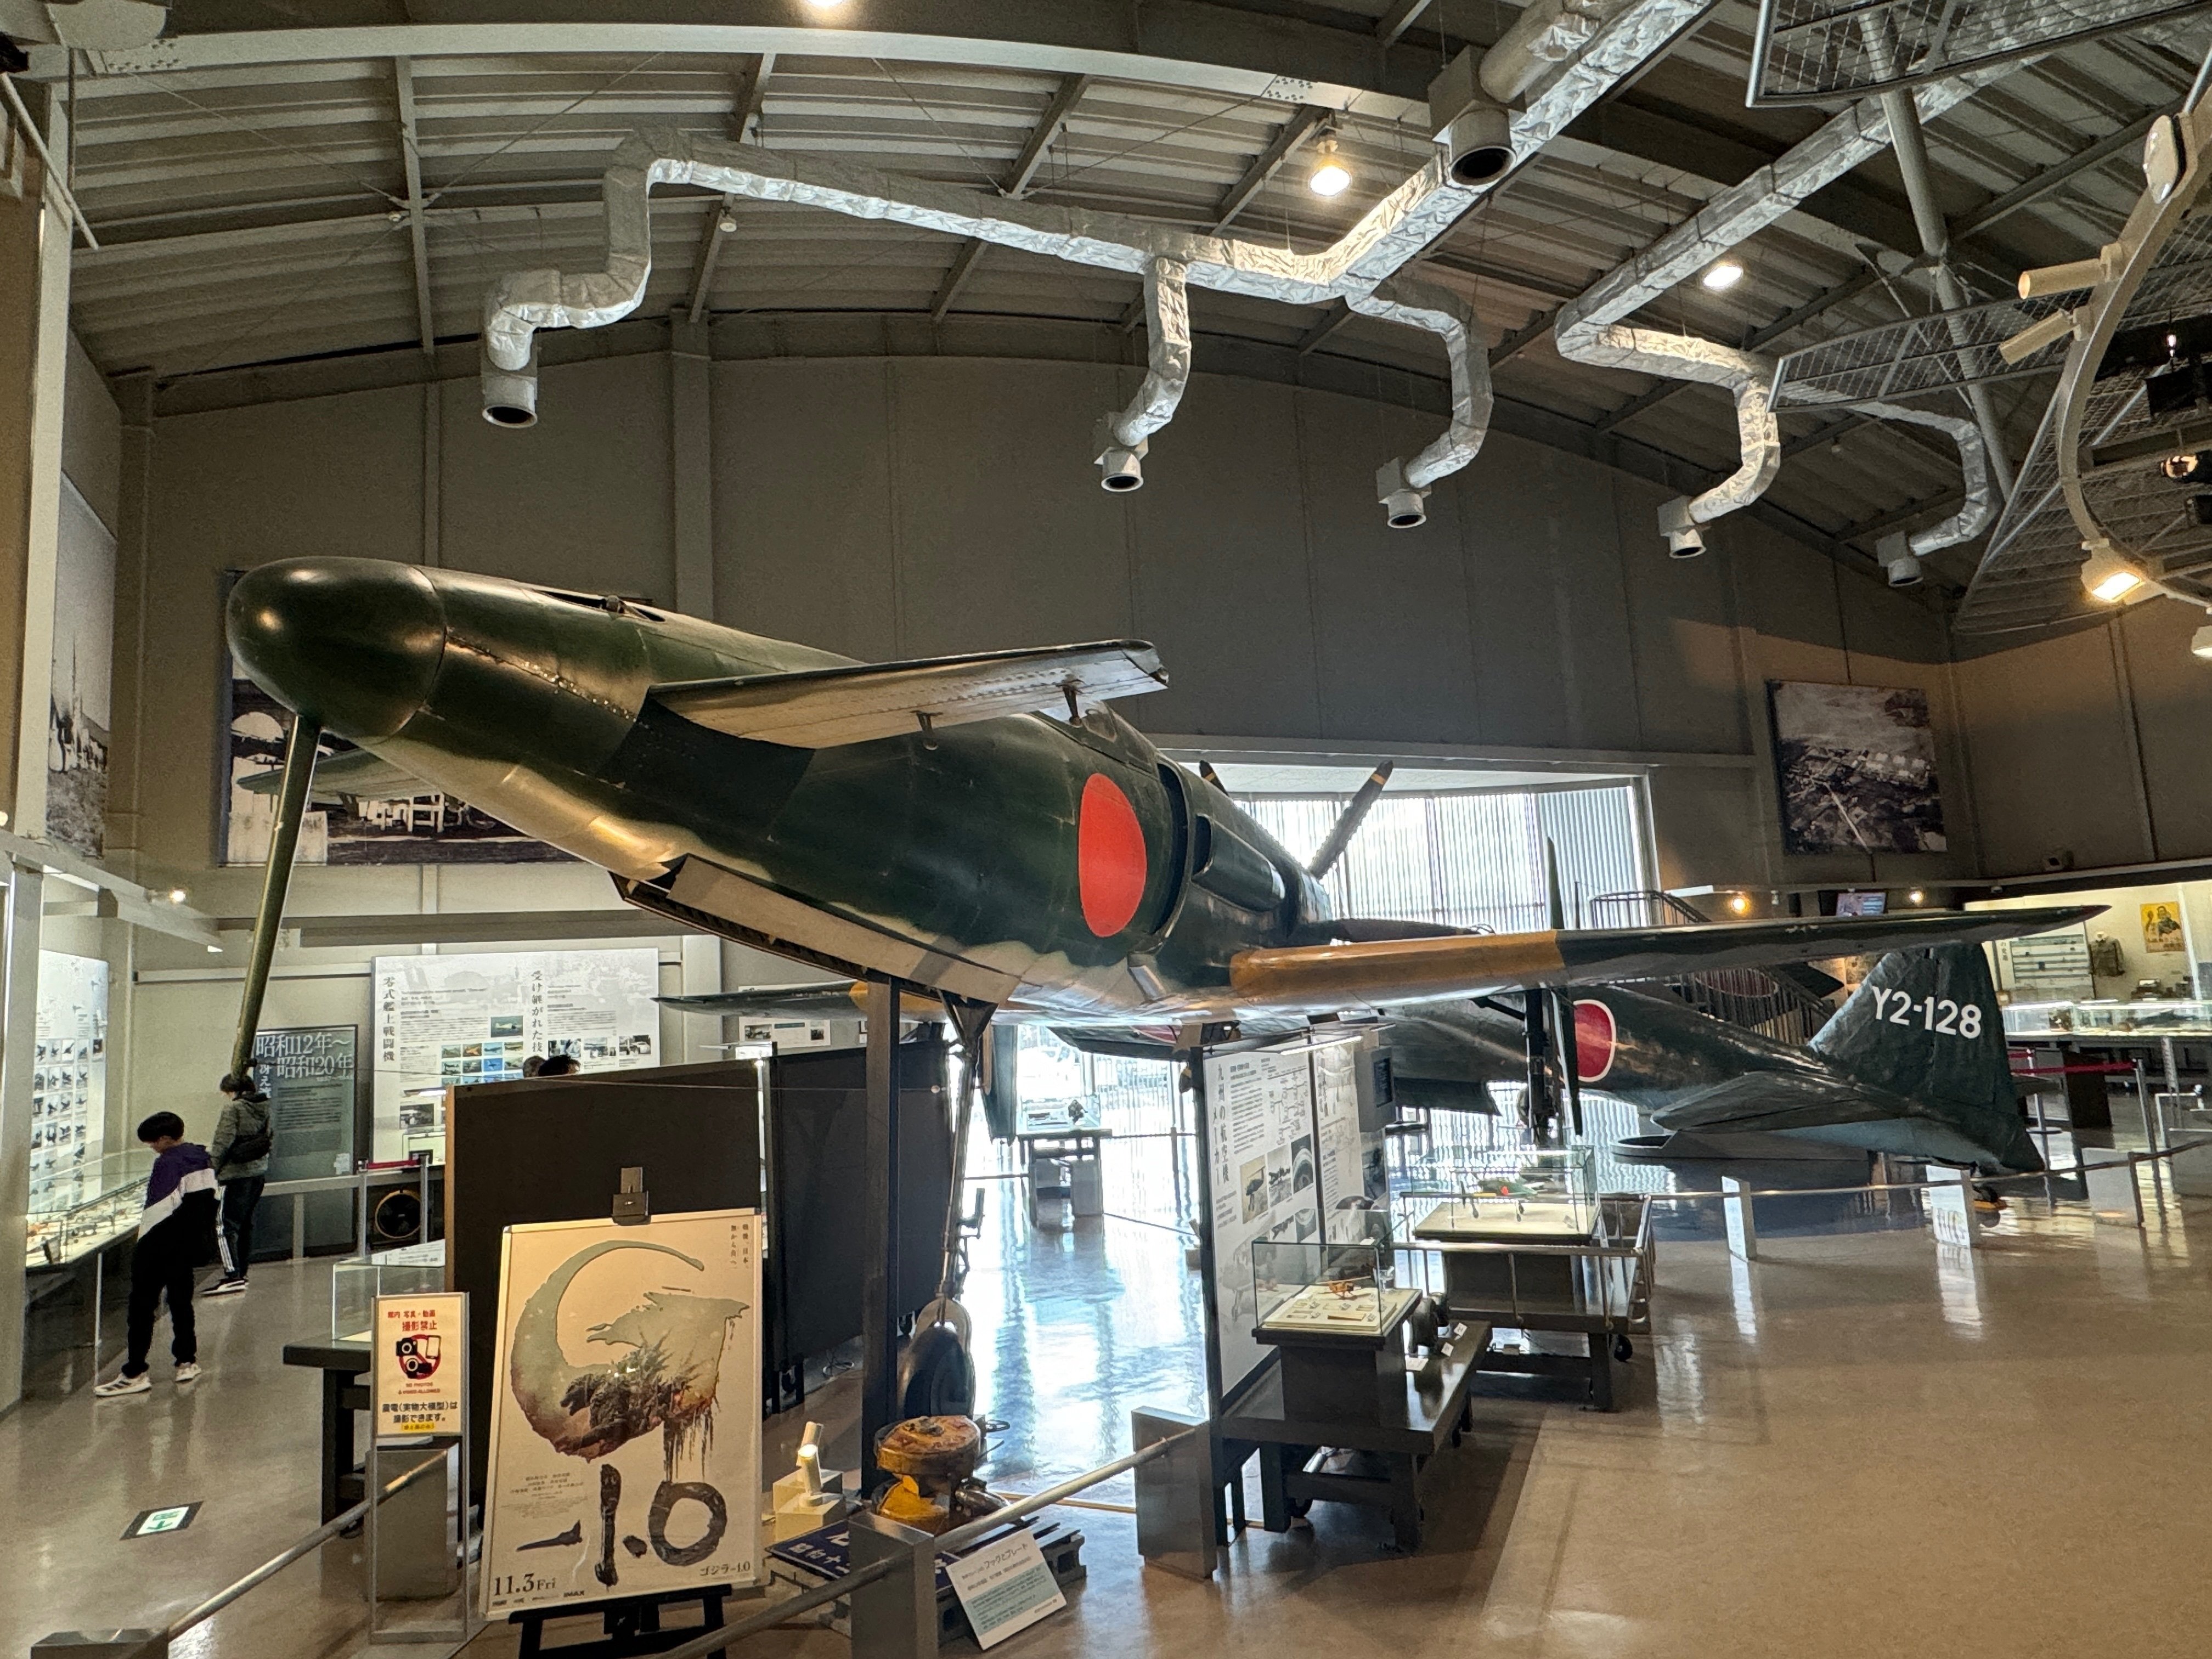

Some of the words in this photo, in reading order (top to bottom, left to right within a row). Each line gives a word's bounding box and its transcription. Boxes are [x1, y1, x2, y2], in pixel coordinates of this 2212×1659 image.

[1872, 985, 1982, 1039] Y2-128
[276, 1052, 354, 1079] 昭和20年
[402, 1321, 438, 1331] 撮影禁止
[494, 1572, 534, 1596] 11.3
[537, 1577, 557, 1591] Fri
